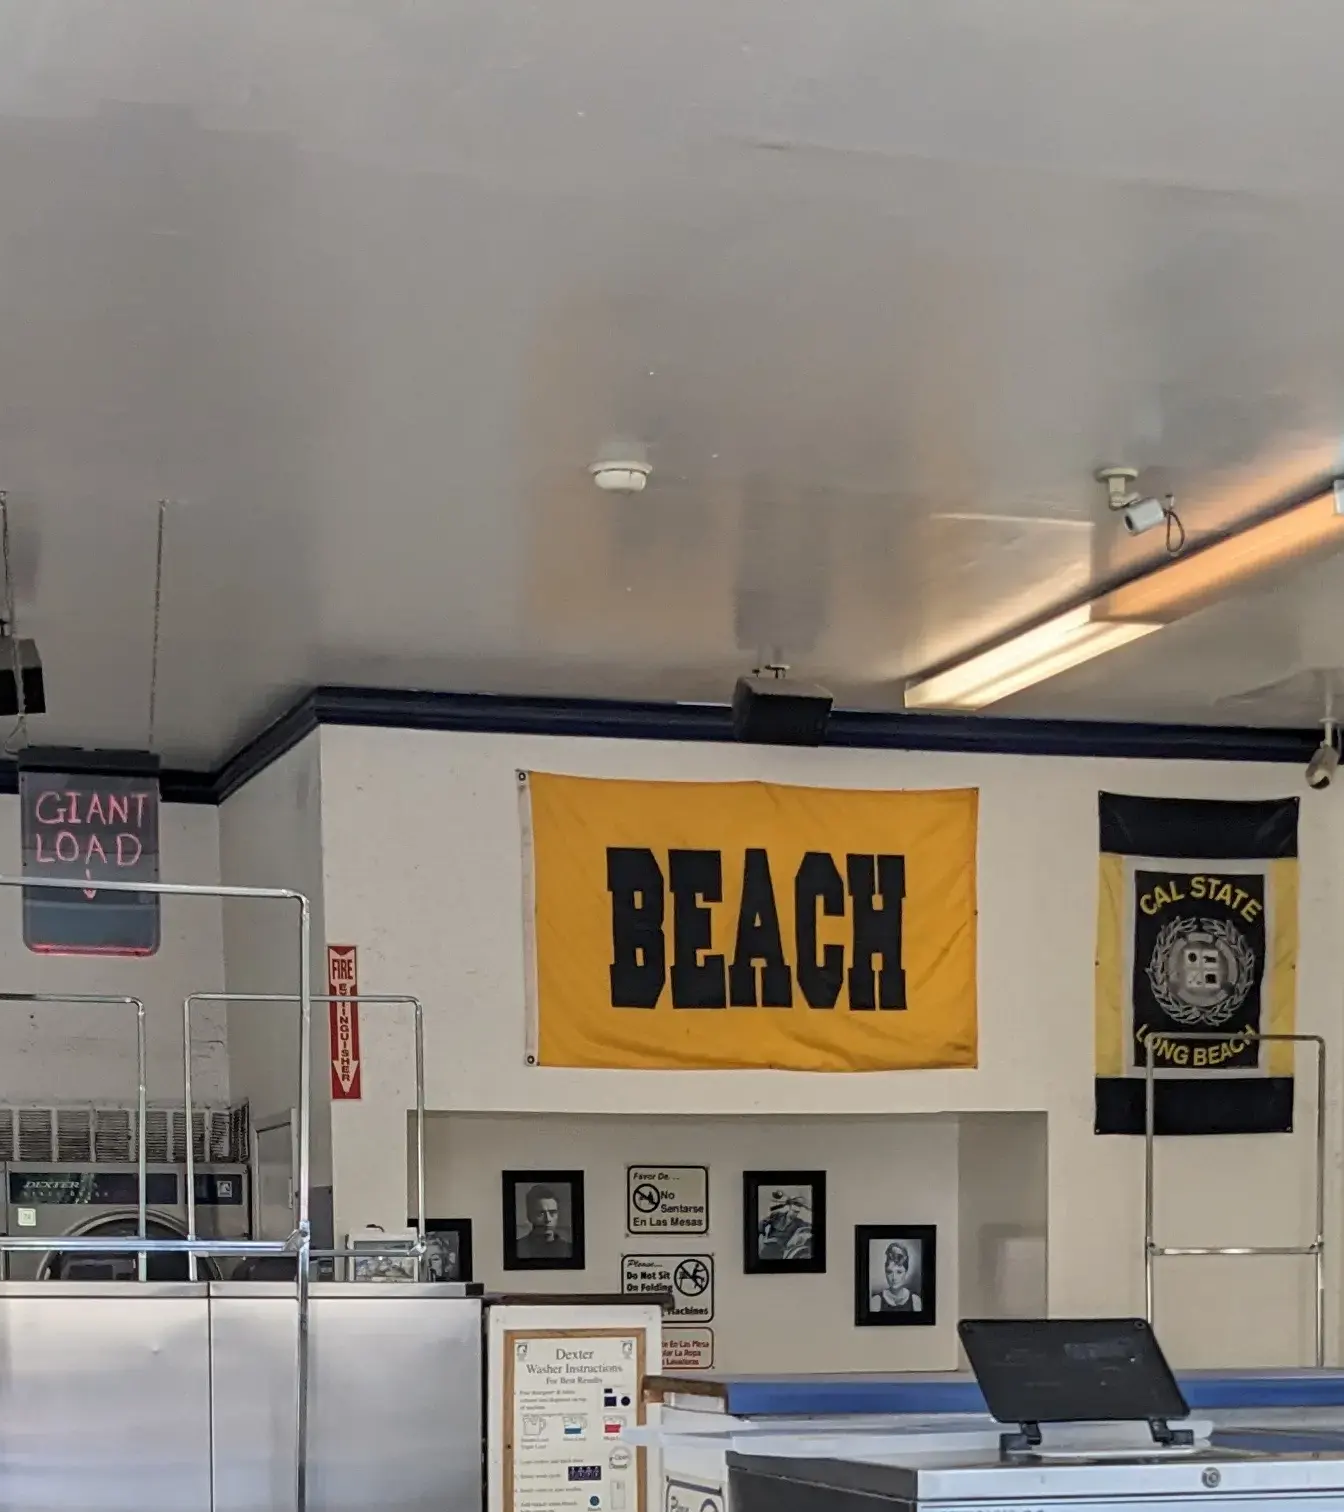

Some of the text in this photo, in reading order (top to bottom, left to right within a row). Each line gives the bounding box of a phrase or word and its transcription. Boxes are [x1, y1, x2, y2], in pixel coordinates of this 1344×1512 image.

[35, 790, 149, 828] GIANT
[36, 831, 143, 866] LOAD
[1140, 876, 1262, 922] CAL STATE
[606, 847, 907, 1011] BEACH
[332, 959, 353, 980] FIRE
[1136, 1024, 1257, 1066] LONG BEACH
[633, 1172, 656, 1180] Favor
[23, 1181, 80, 1189] DEXTER
[660, 1191, 675, 1200] No
[661, 1204, 704, 1213] Sentarse
[633, 1217, 703, 1226] En Las Mesas
[626, 1271, 670, 1280] Do Not Sit
[626, 1283, 673, 1293] On Folding
[668, 1307, 708, 1315] Machines
[670, 1340, 678, 1348] En
[680, 1340, 690, 1348] Las
[556, 1348, 594, 1360] Dexter
[526, 1363, 623, 1374] Washer Instructions
[546, 1377, 558, 1385] For
